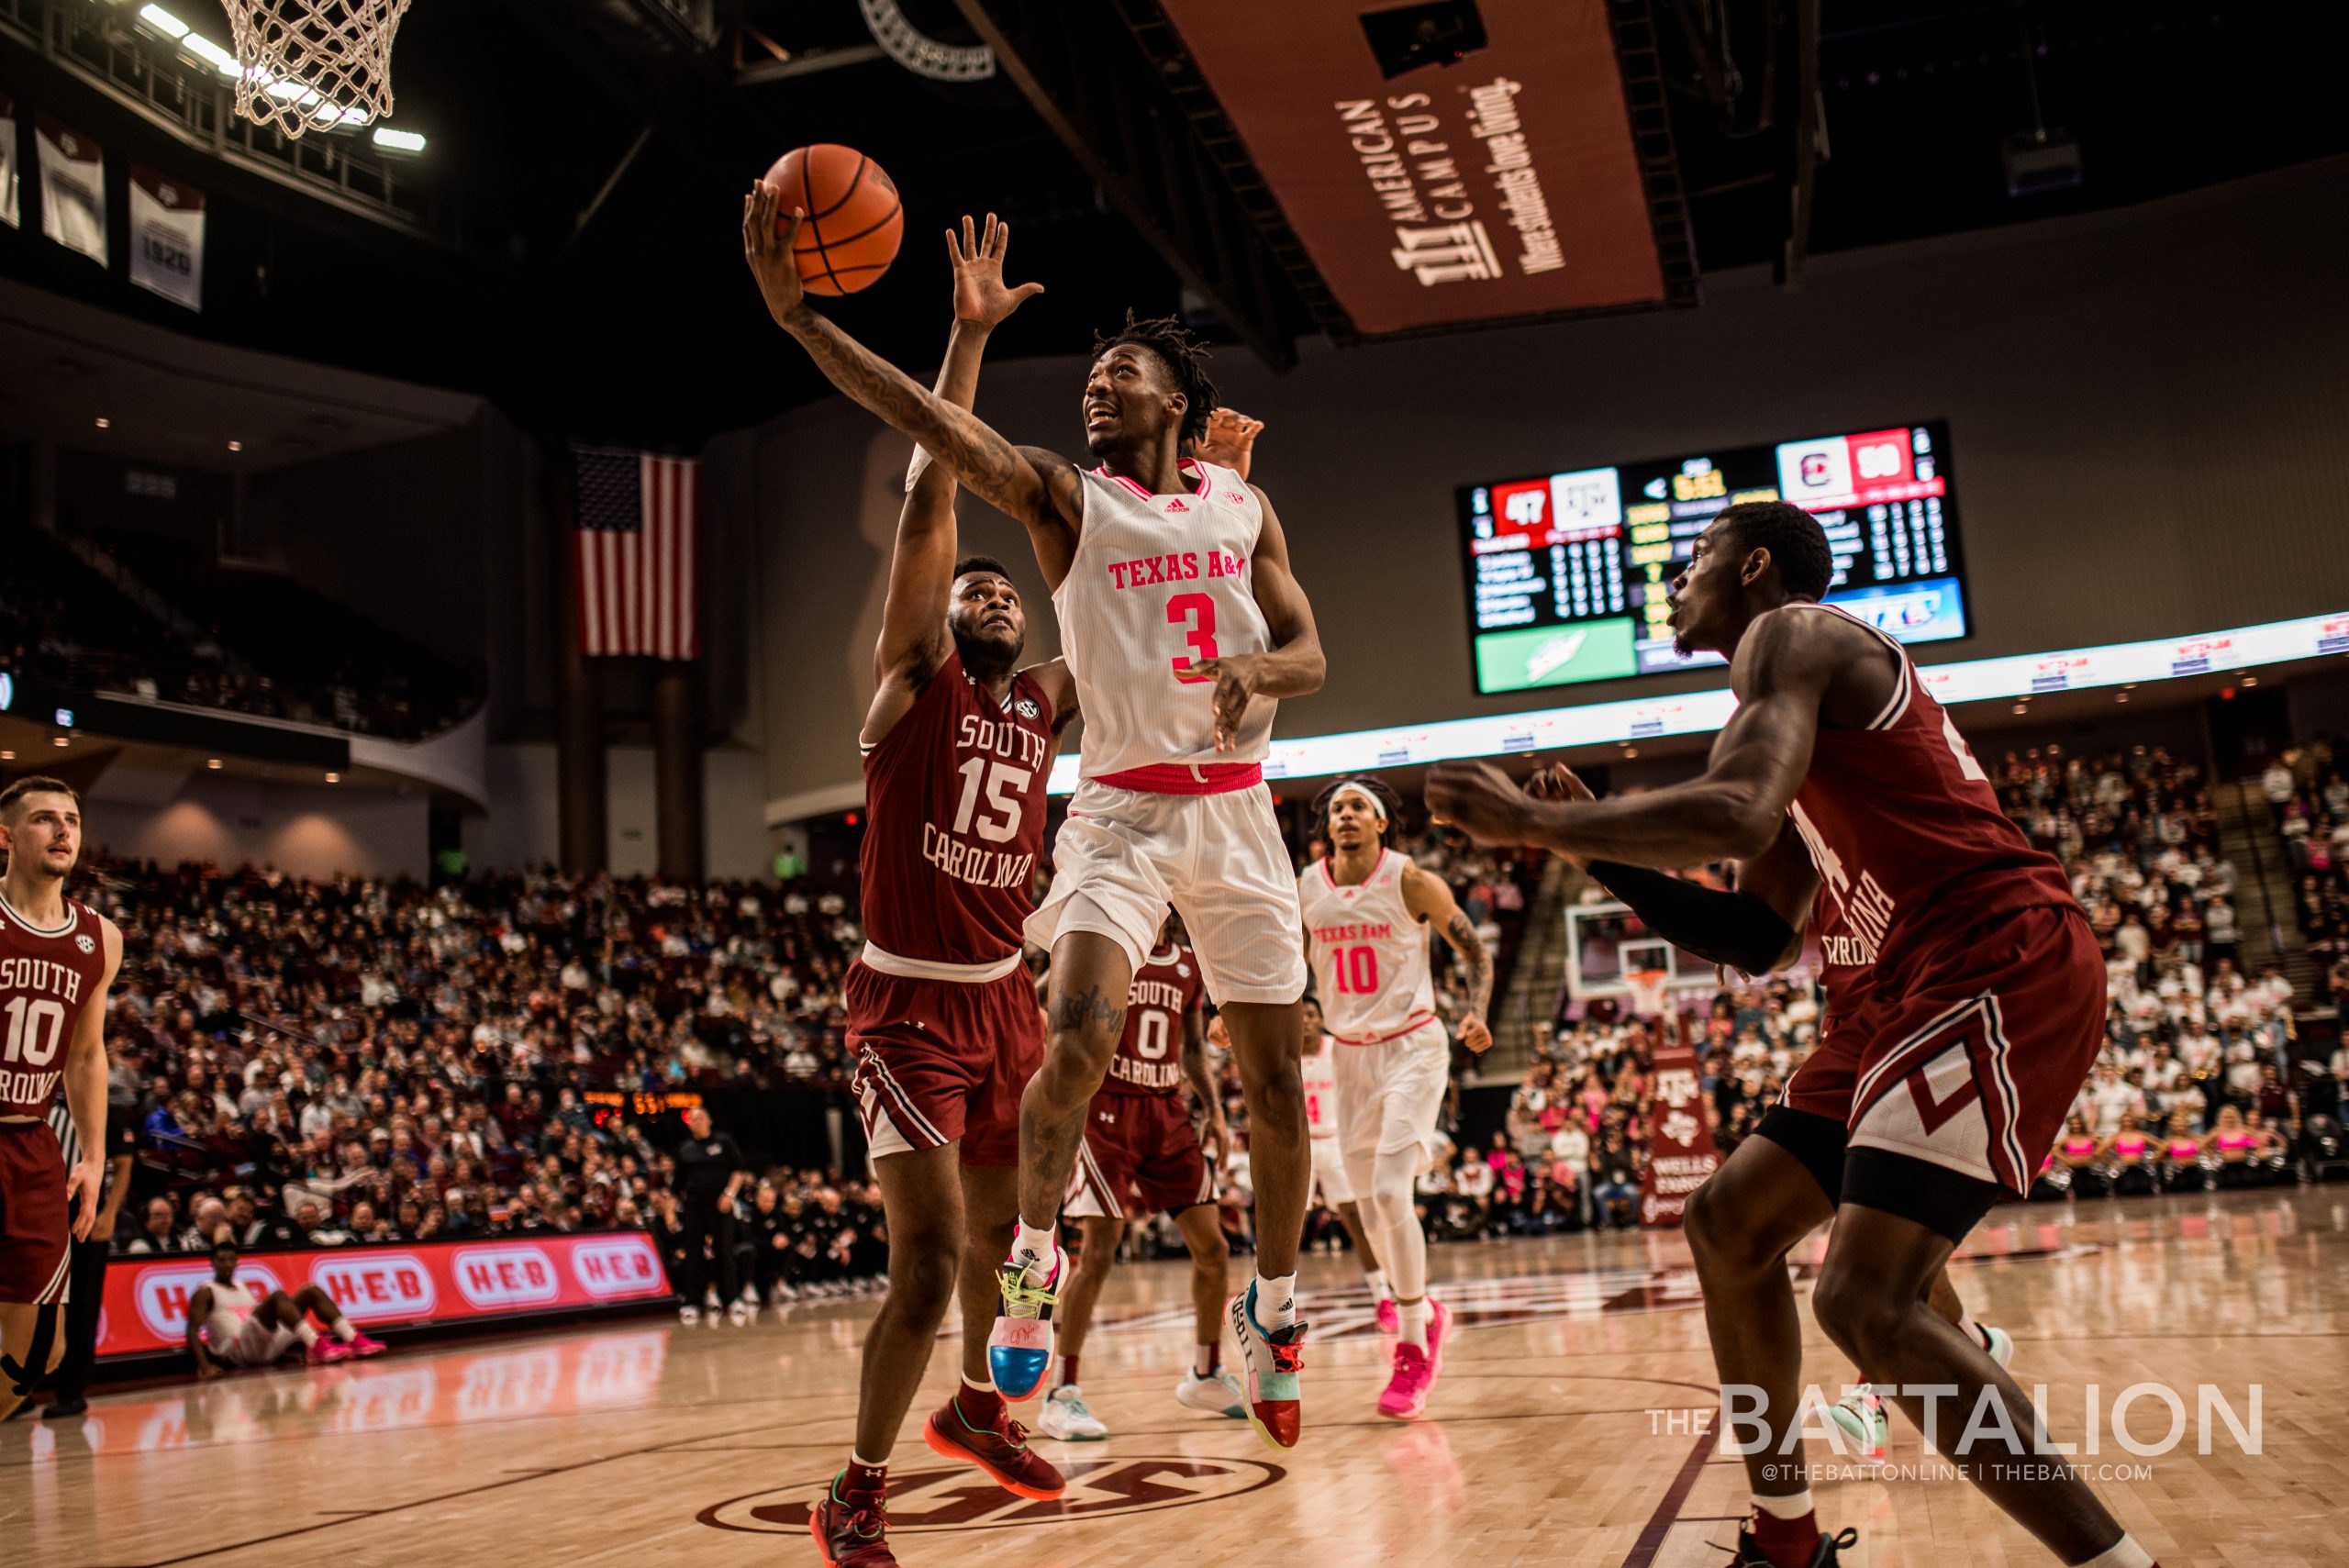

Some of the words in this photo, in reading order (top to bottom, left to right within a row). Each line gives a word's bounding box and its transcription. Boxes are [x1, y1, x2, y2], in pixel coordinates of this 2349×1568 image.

[1334, 99, 1428, 222] AMERICAN
[1387, 93, 1474, 219] CAMPUS
[1485, 132, 1532, 174] love
[1494, 166, 1553, 231] students
[142, 234, 192, 277] 1920
[1506, 489, 1546, 526] 47
[1108, 551, 1198, 590] TEXAS
[1166, 592, 1219, 684] 3
[1016, 699, 1039, 718] SEC
[956, 714, 1046, 773] SOUTH
[952, 756, 1032, 843] 15
[923, 821, 1033, 888] CAROLINA
[1313, 926, 1357, 944] TEXAS
[1362, 924, 1392, 940] A&M
[0, 958, 82, 1005] SOUTH
[1331, 946, 1378, 995] 10
[1128, 980, 1183, 1014] SOUTH
[4, 995, 65, 1066] 10
[1137, 1009, 1169, 1060] 0
[1653, 1154, 1719, 1175] WELLS
